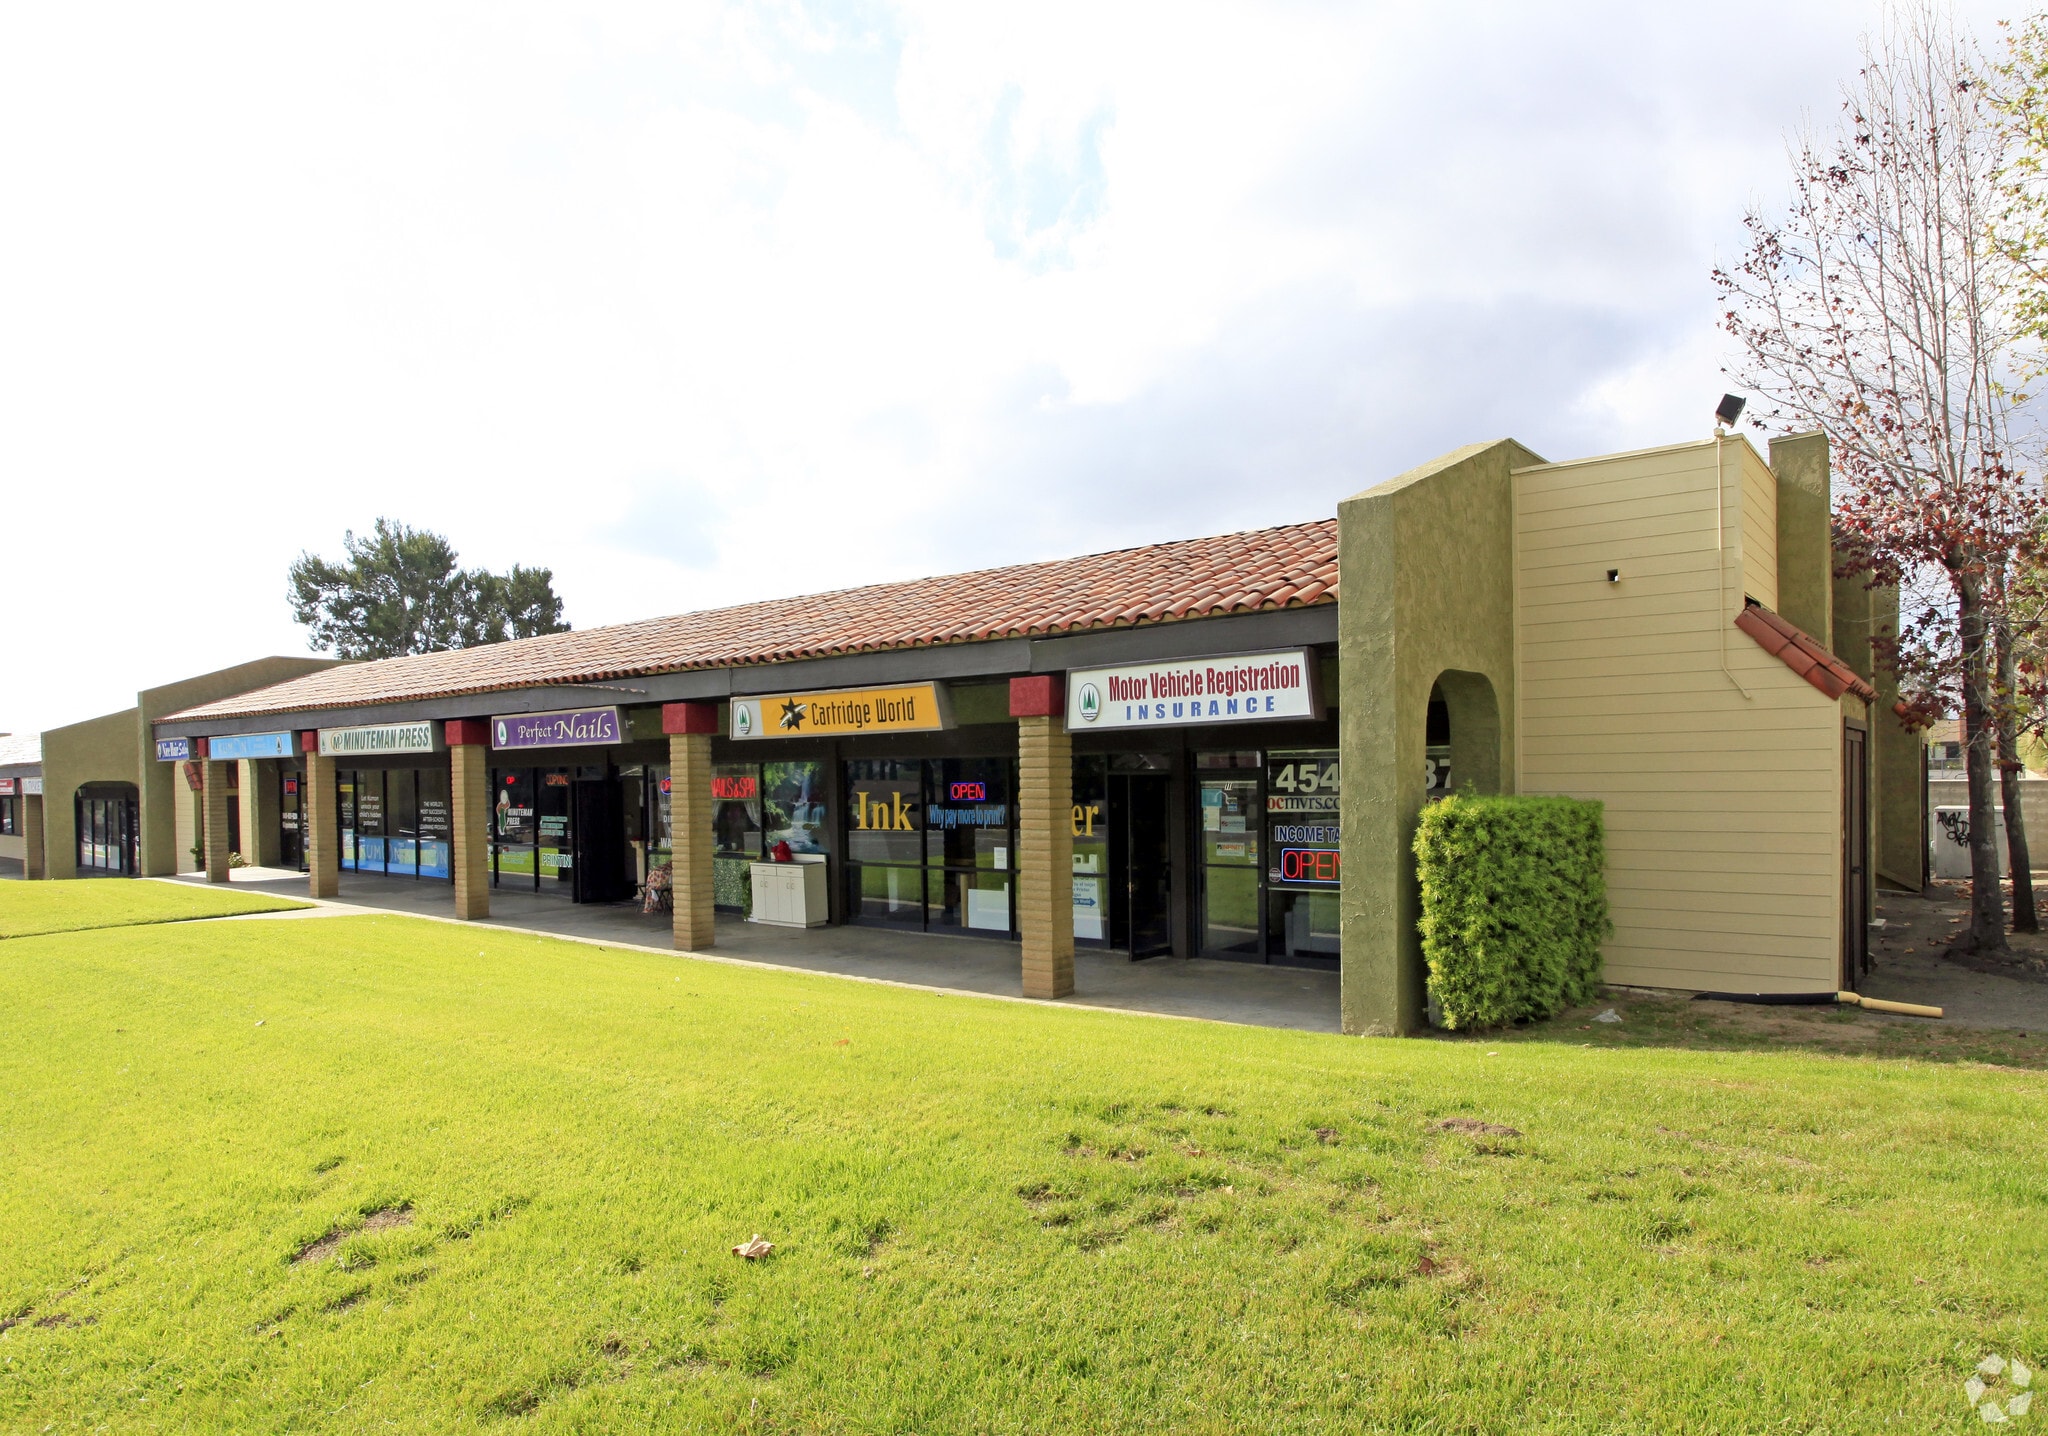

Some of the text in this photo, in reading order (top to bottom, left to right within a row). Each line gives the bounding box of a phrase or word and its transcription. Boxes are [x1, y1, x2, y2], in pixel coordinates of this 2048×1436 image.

[1108, 661, 1300, 702] Motor Vehicle Registration
[811, 696, 915, 728] Cartridge World
[1126, 695, 1275, 721] INSURANCE
[343, 726, 430, 750] MINUTEMAN PRESS
[518, 713, 612, 745] Perfect Nails
[951, 784, 985, 799] OPEN
[507, 808, 533, 817] MINUTEMAN
[507, 817, 520, 825] PRESS
[856, 791, 914, 831] Ink
[929, 804, 1005, 829] Why pay more to print?
[1275, 825, 1341, 843] INCOME TA
